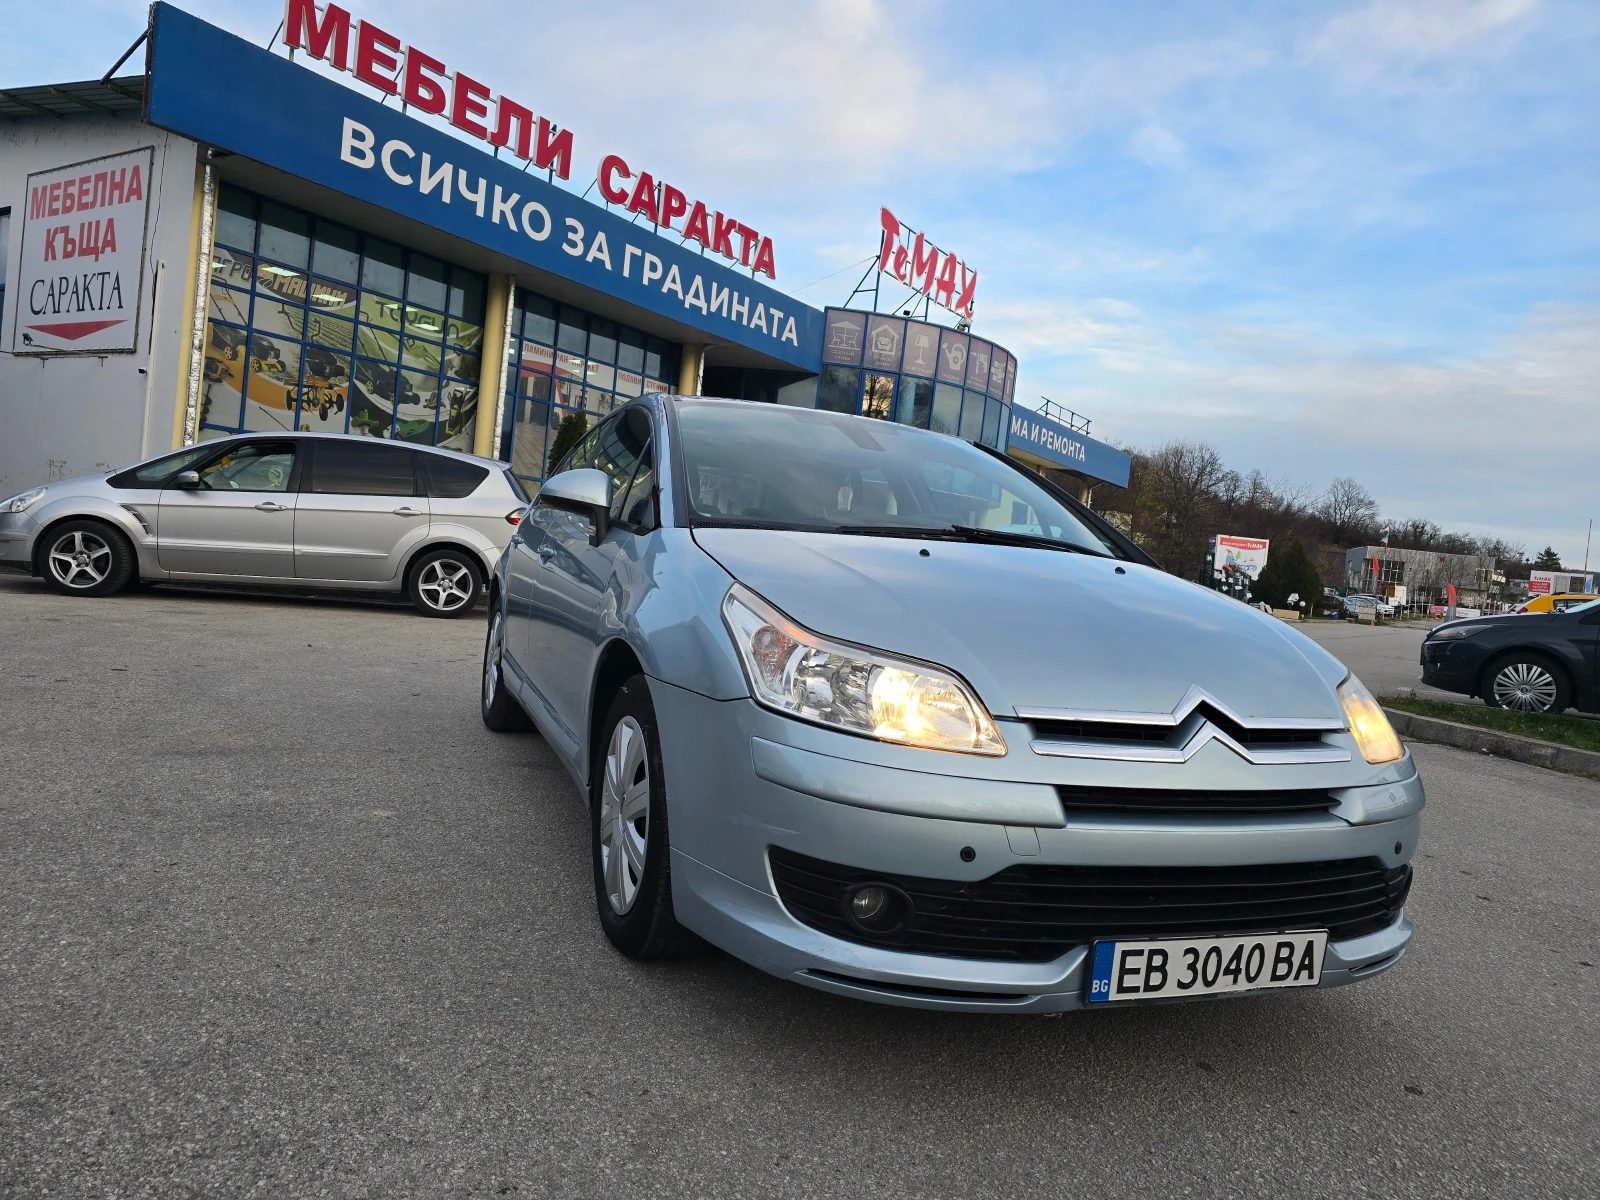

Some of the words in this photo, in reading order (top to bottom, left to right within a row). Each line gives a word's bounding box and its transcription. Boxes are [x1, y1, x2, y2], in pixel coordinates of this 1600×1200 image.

[282, 0, 574, 181] МЕБЕЛИ
[597, 154, 777, 281] САРАКТА
[29, 164, 143, 220] МЕБЕЛНА
[43, 217, 117, 262] КЪЩА
[340, 116, 552, 242] ВСИЧКО
[561, 217, 613, 271] ЗА
[622, 243, 799, 347] ГРАДИНАТА
[29, 270, 124, 315] САРАКТА
[524, 343, 569, 364] ЛАМИНИРАН
[617, 371, 642, 386] ПОДОВИ
[646, 380, 668, 393] СТЕННИ
[1031, 423, 1040, 443] И
[1040, 427, 1086, 462] РЕМОНТА
[1091, 979, 1109, 994] BG
[1116, 948, 1169, 995] EB
[1176, 943, 1266, 990] 3040
[1270, 939, 1315, 983] BA
